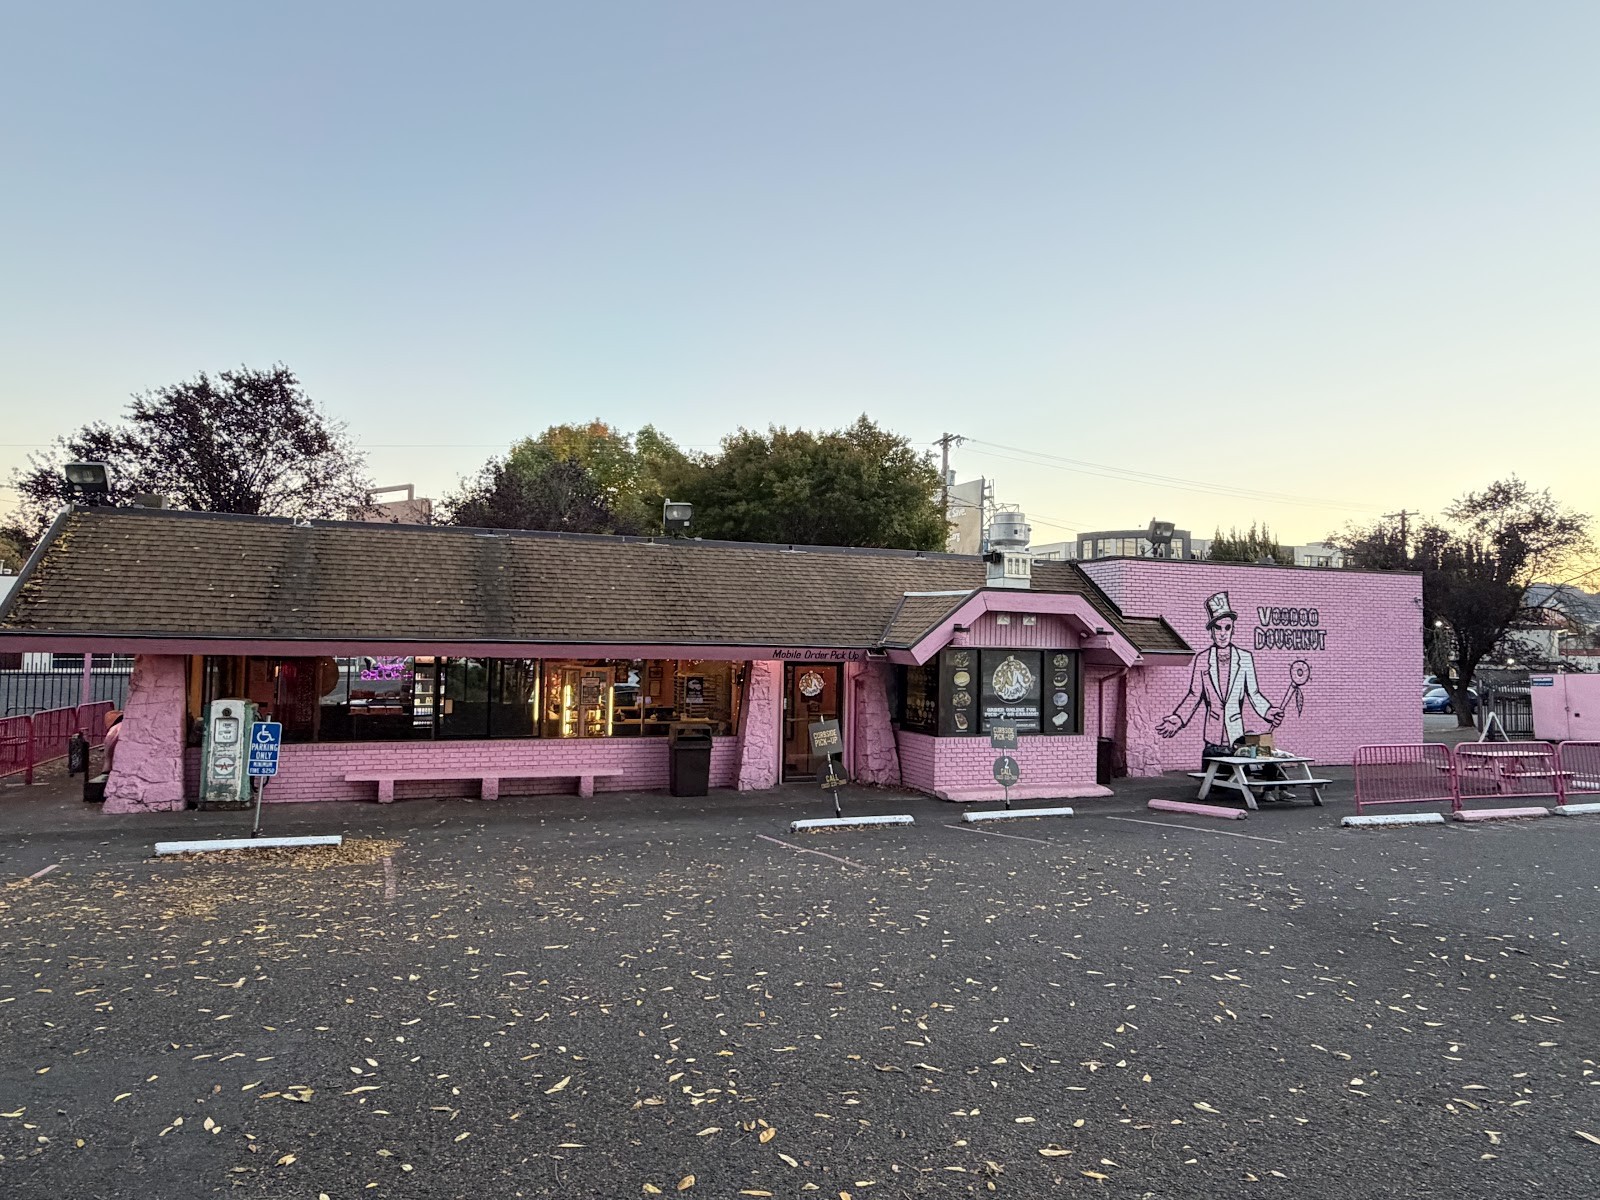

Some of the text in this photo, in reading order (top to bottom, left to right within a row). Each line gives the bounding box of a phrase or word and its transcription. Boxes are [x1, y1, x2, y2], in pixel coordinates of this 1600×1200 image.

[1257, 606, 1319, 627] VOODOO
[1254, 626, 1327, 650] DOUGHNUT
[772, 649, 860, 662] Mobile Order Pick Up
[813, 728, 837, 739] CURBSIDE
[815, 737, 837, 747] PICK-UP
[251, 743, 278, 752] PARKING
[1004, 758, 1009, 768] 2
[1000, 767, 1012, 775] CALL
[825, 773, 839, 783] CALL
